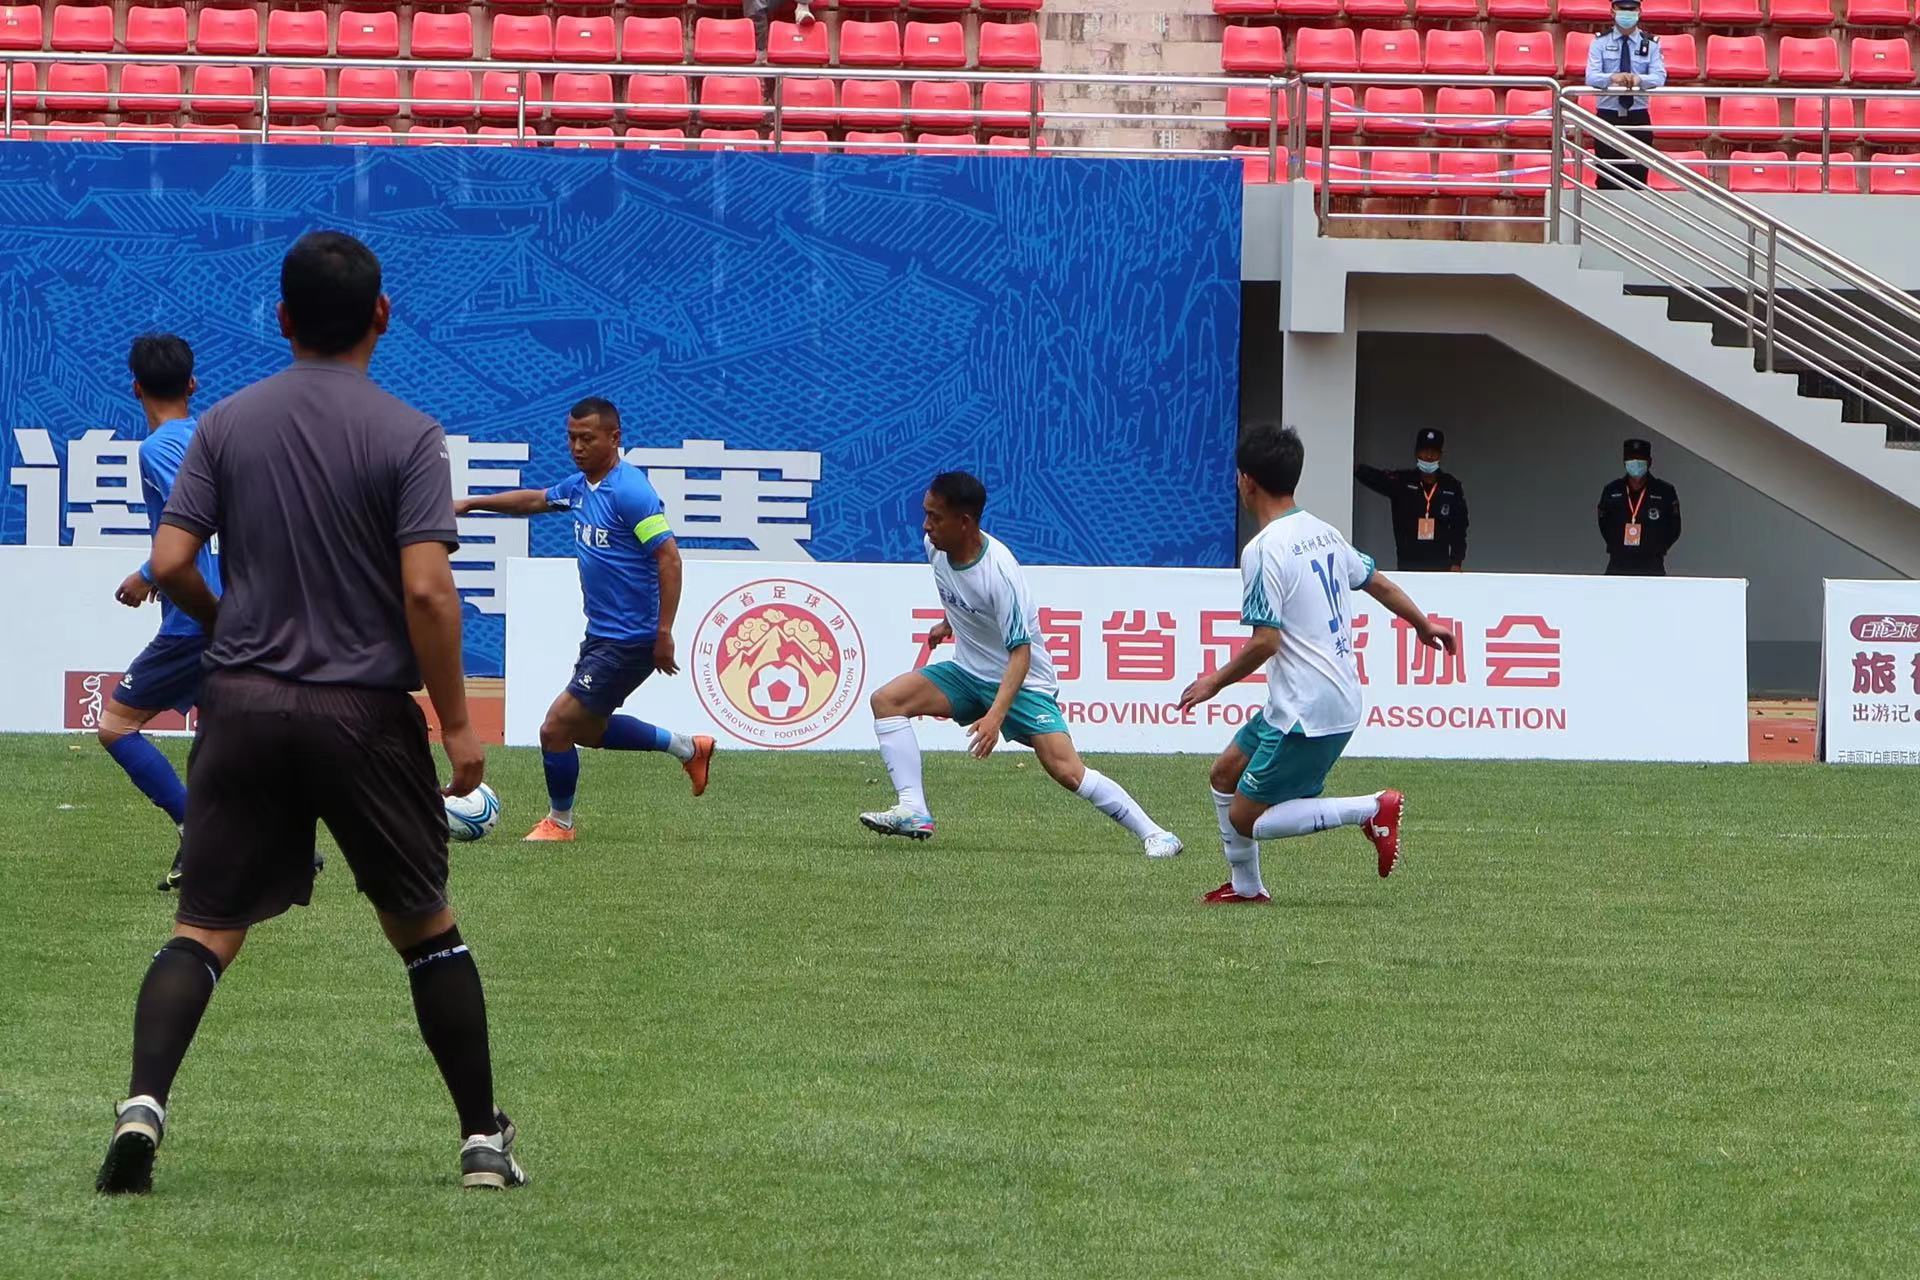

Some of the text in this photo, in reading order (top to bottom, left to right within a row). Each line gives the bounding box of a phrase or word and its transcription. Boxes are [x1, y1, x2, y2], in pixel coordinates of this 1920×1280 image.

[698, 585, 858, 661] 云南省足球协会
[1852, 651, 1920, 694] 旅
[702, 661, 855, 739] YUNNAN PROVINCE FOOTBALL ASSOCIATION
[1852, 703, 1911, 723] 出游记
[1366, 705, 1566, 730] ASSOCIATION
[1838, 750, 1920, 765] 云南丽江白鹿国际旅
